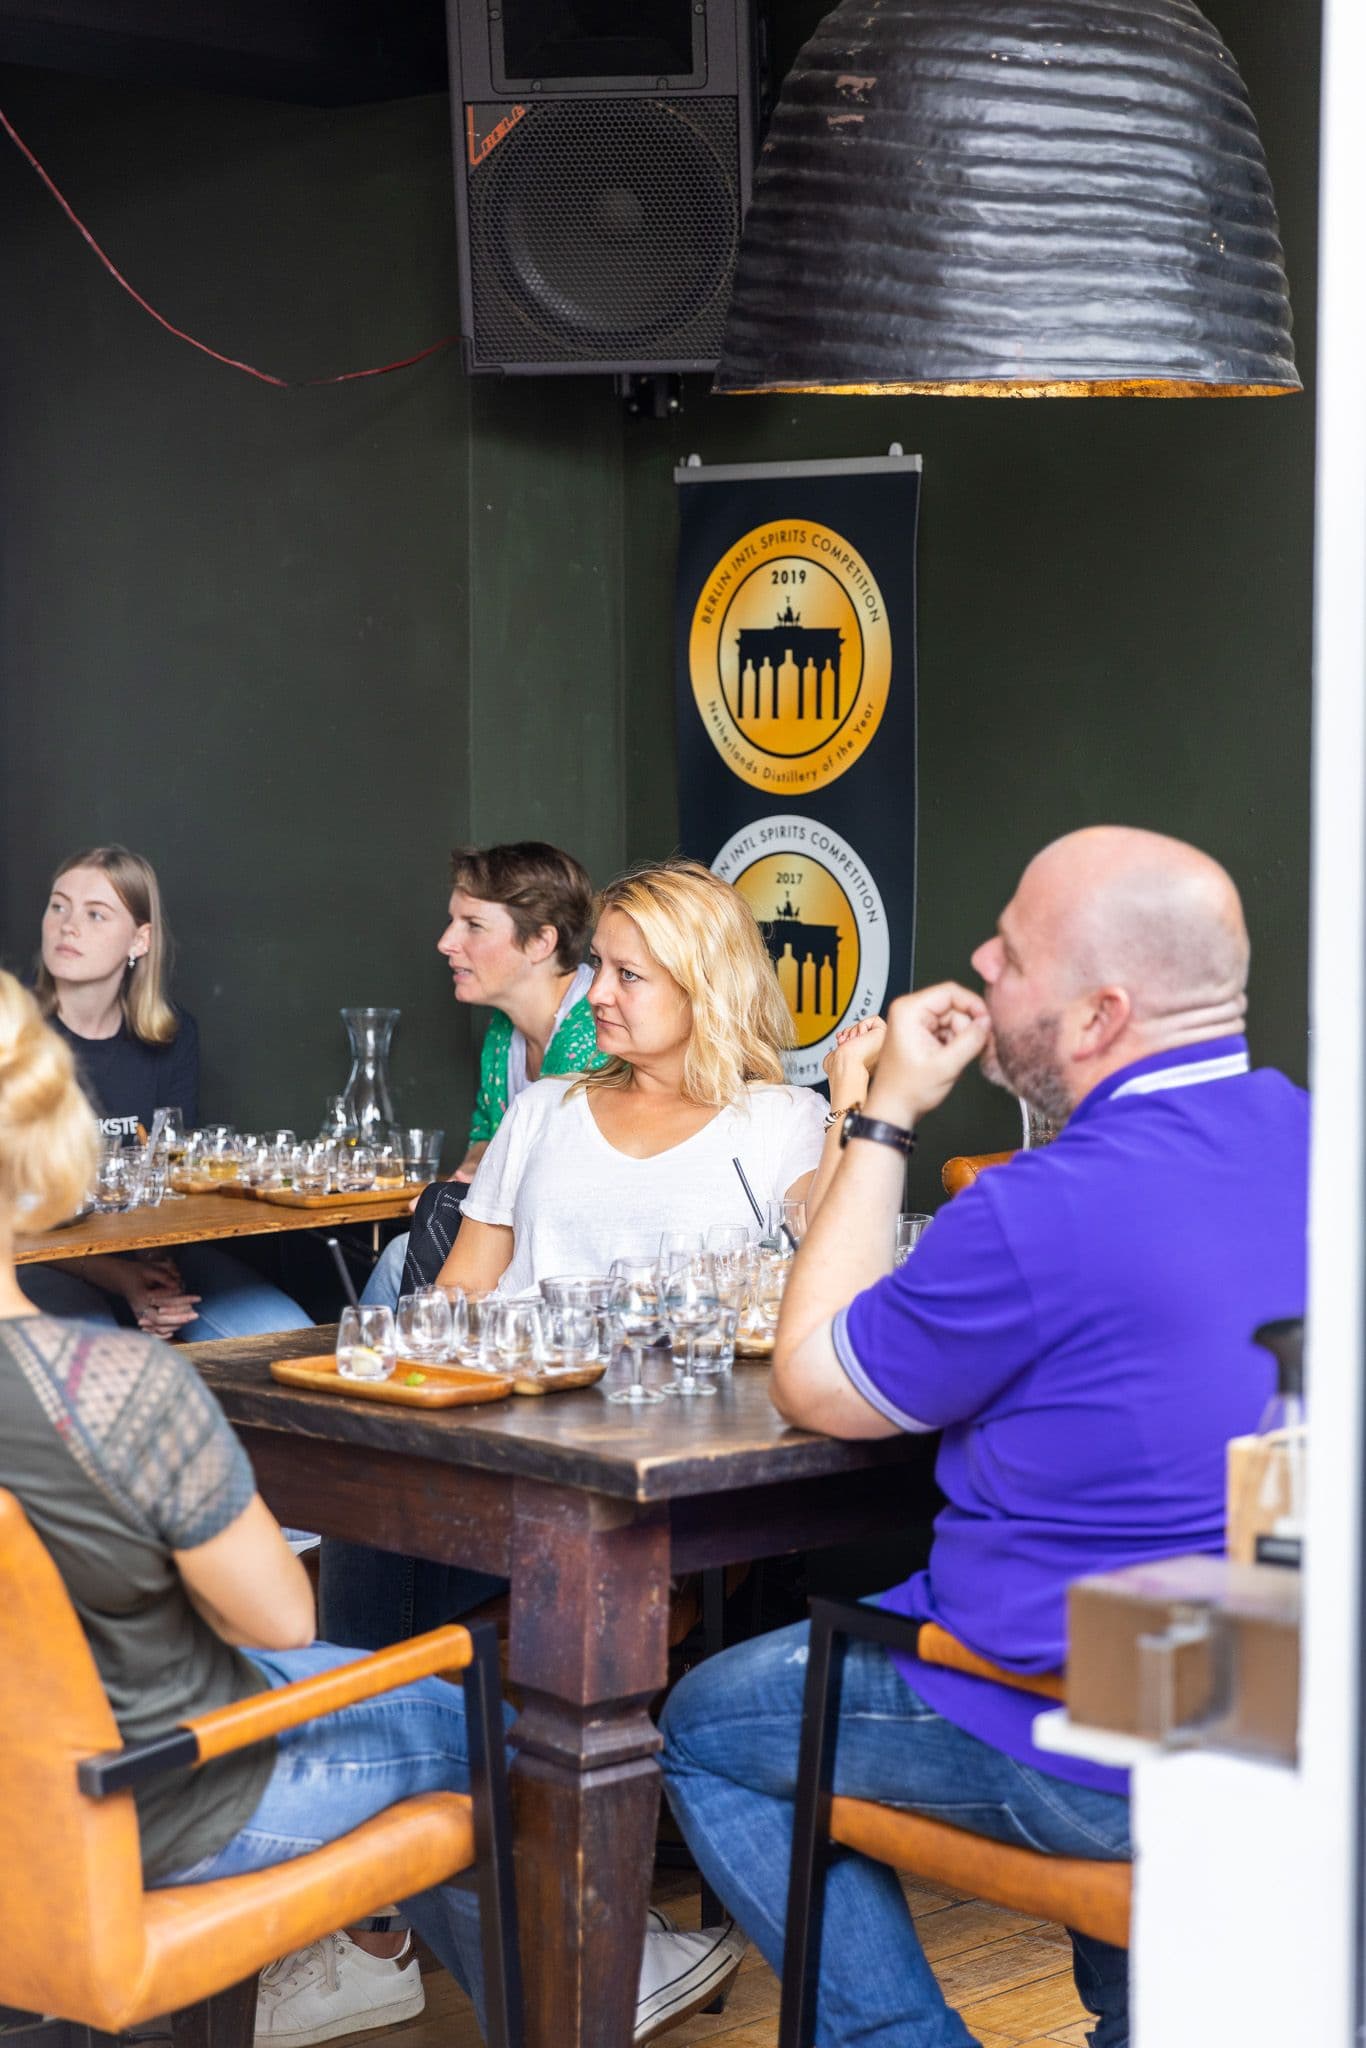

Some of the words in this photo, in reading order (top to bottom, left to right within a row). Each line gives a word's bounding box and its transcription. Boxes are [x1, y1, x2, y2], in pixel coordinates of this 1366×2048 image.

[701, 571, 732, 624] BERLIN
[760, 529, 807, 549] SPIRITS
[811, 534, 880, 623] COMPETITION
[771, 569, 807, 585] 2019
[707, 700, 758, 775] Netherlands
[763, 767, 818, 784] Distillery
[822, 758, 836, 772] of
[836, 740, 854, 760] the
[853, 702, 874, 735] Year
[760, 825, 806, 844] SPIRITS
[810, 832, 880, 924] COMPETITION
[776, 872, 803, 885] 2017
